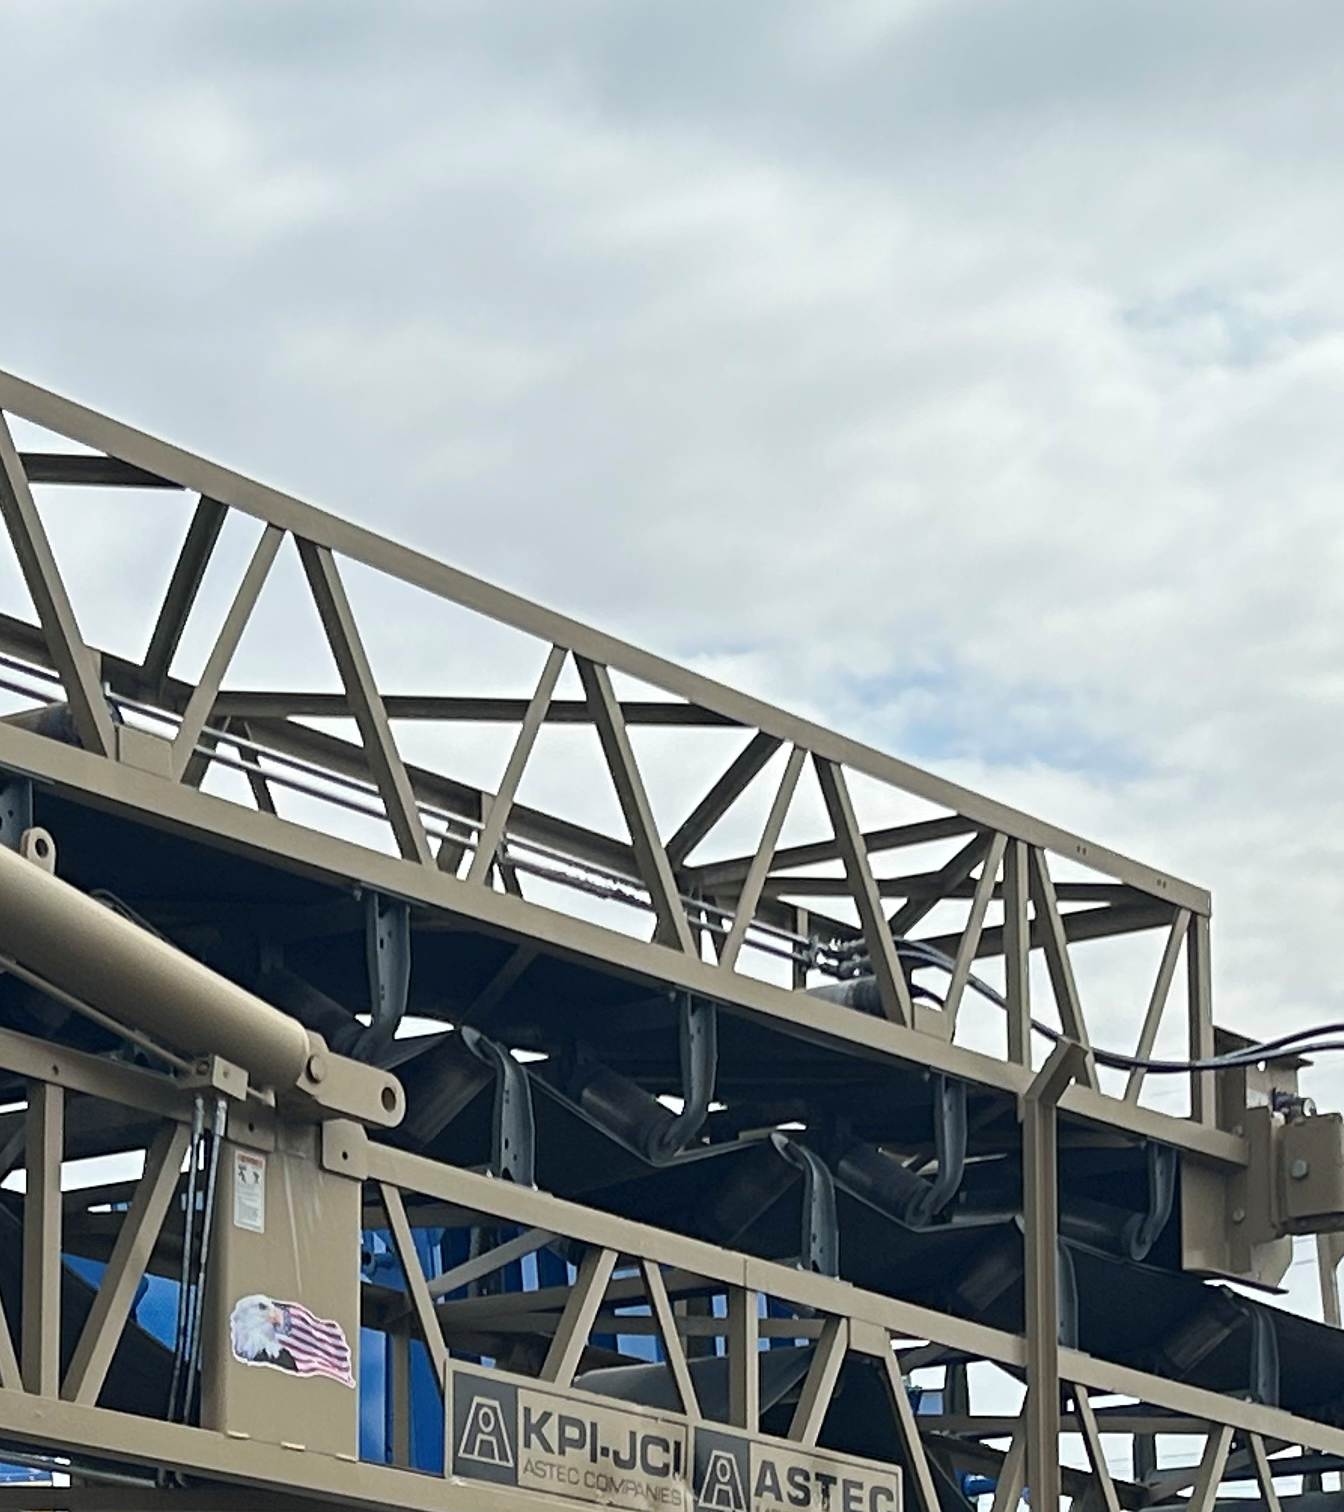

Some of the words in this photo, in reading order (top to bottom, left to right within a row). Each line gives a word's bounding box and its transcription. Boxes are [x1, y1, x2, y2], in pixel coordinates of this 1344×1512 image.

[522, 1406, 682, 1479] KPI-JCI
[522, 1457, 580, 1487] ASTEC
[583, 1469, 683, 1507] COMPANIES
